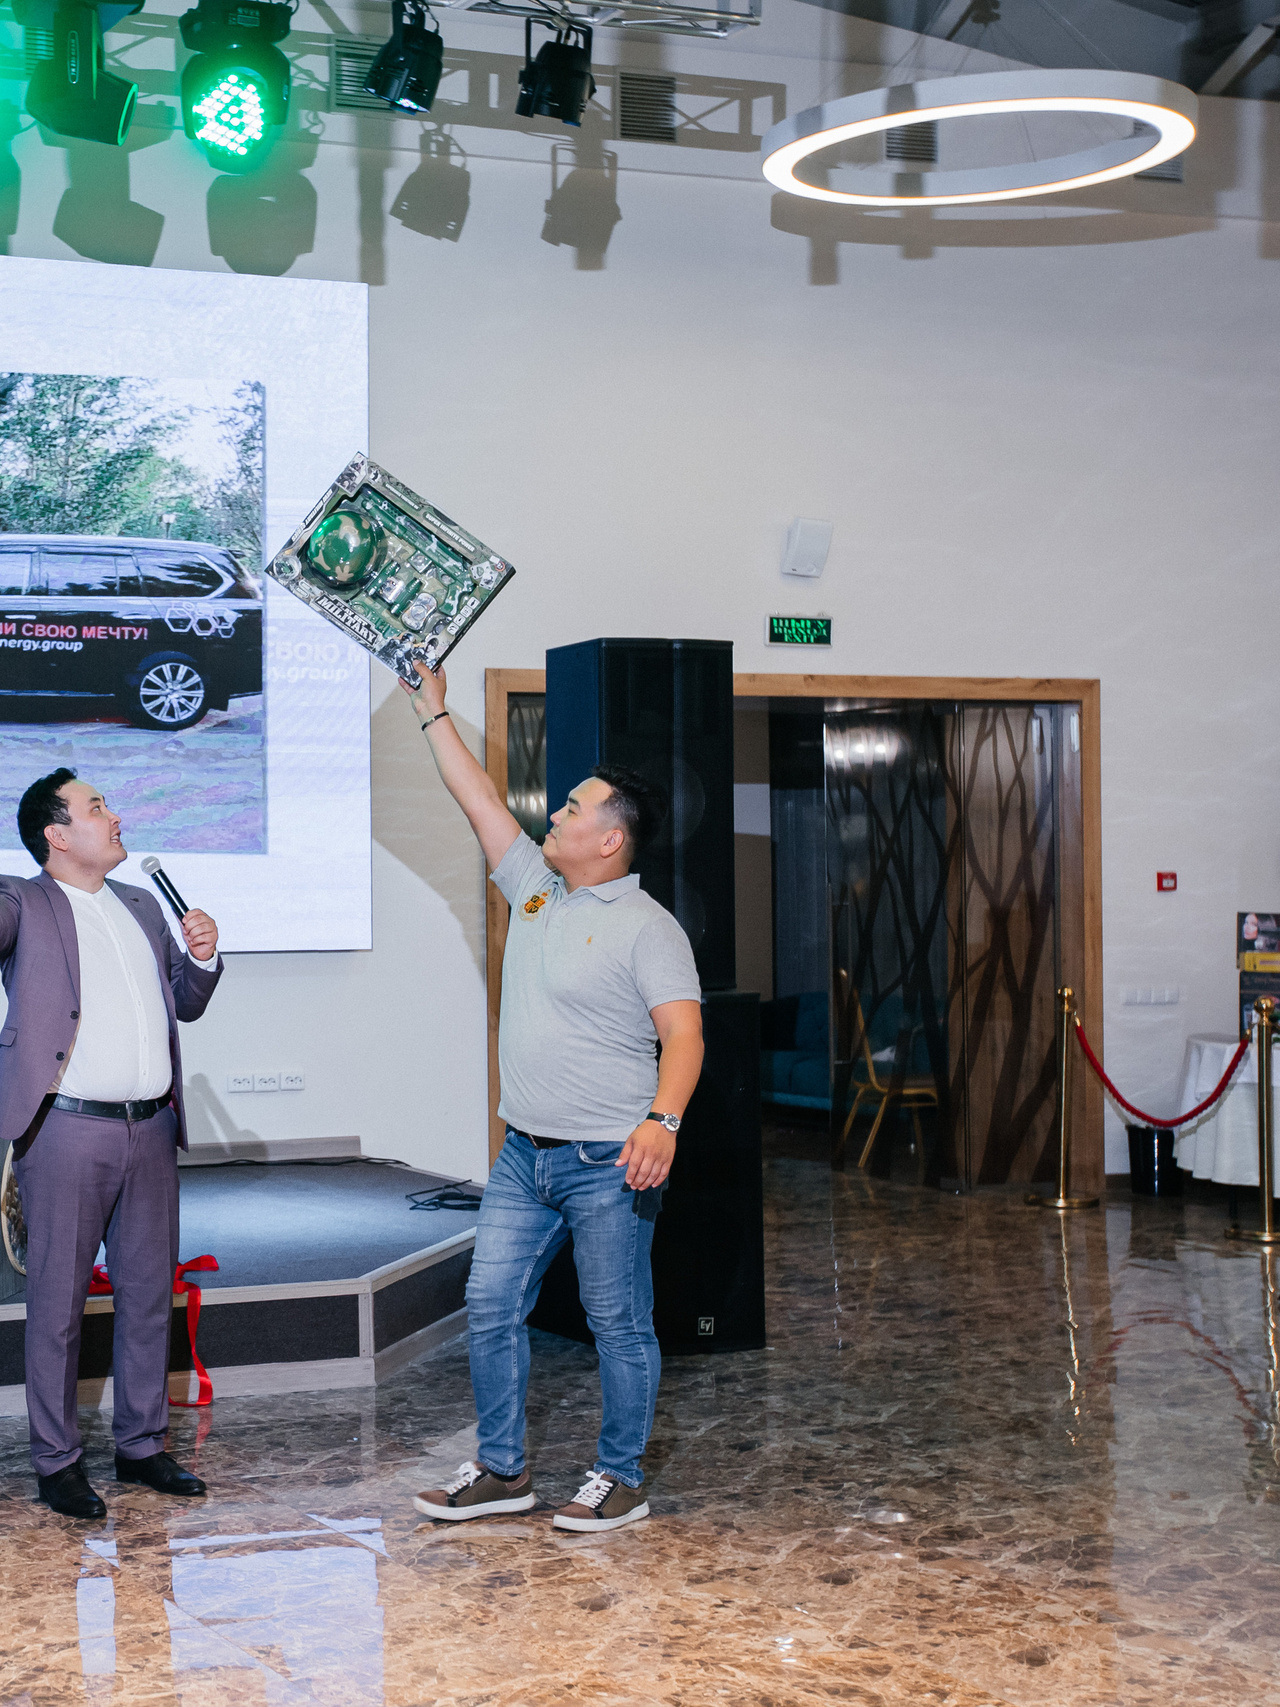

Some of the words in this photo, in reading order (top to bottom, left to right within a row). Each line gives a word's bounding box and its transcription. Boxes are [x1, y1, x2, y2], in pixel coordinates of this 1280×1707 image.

[21, 623, 77, 639] СВОЮ
[82, 625, 149, 640] МЕЧТУ!
[317, 597, 377, 644] MILITARY
